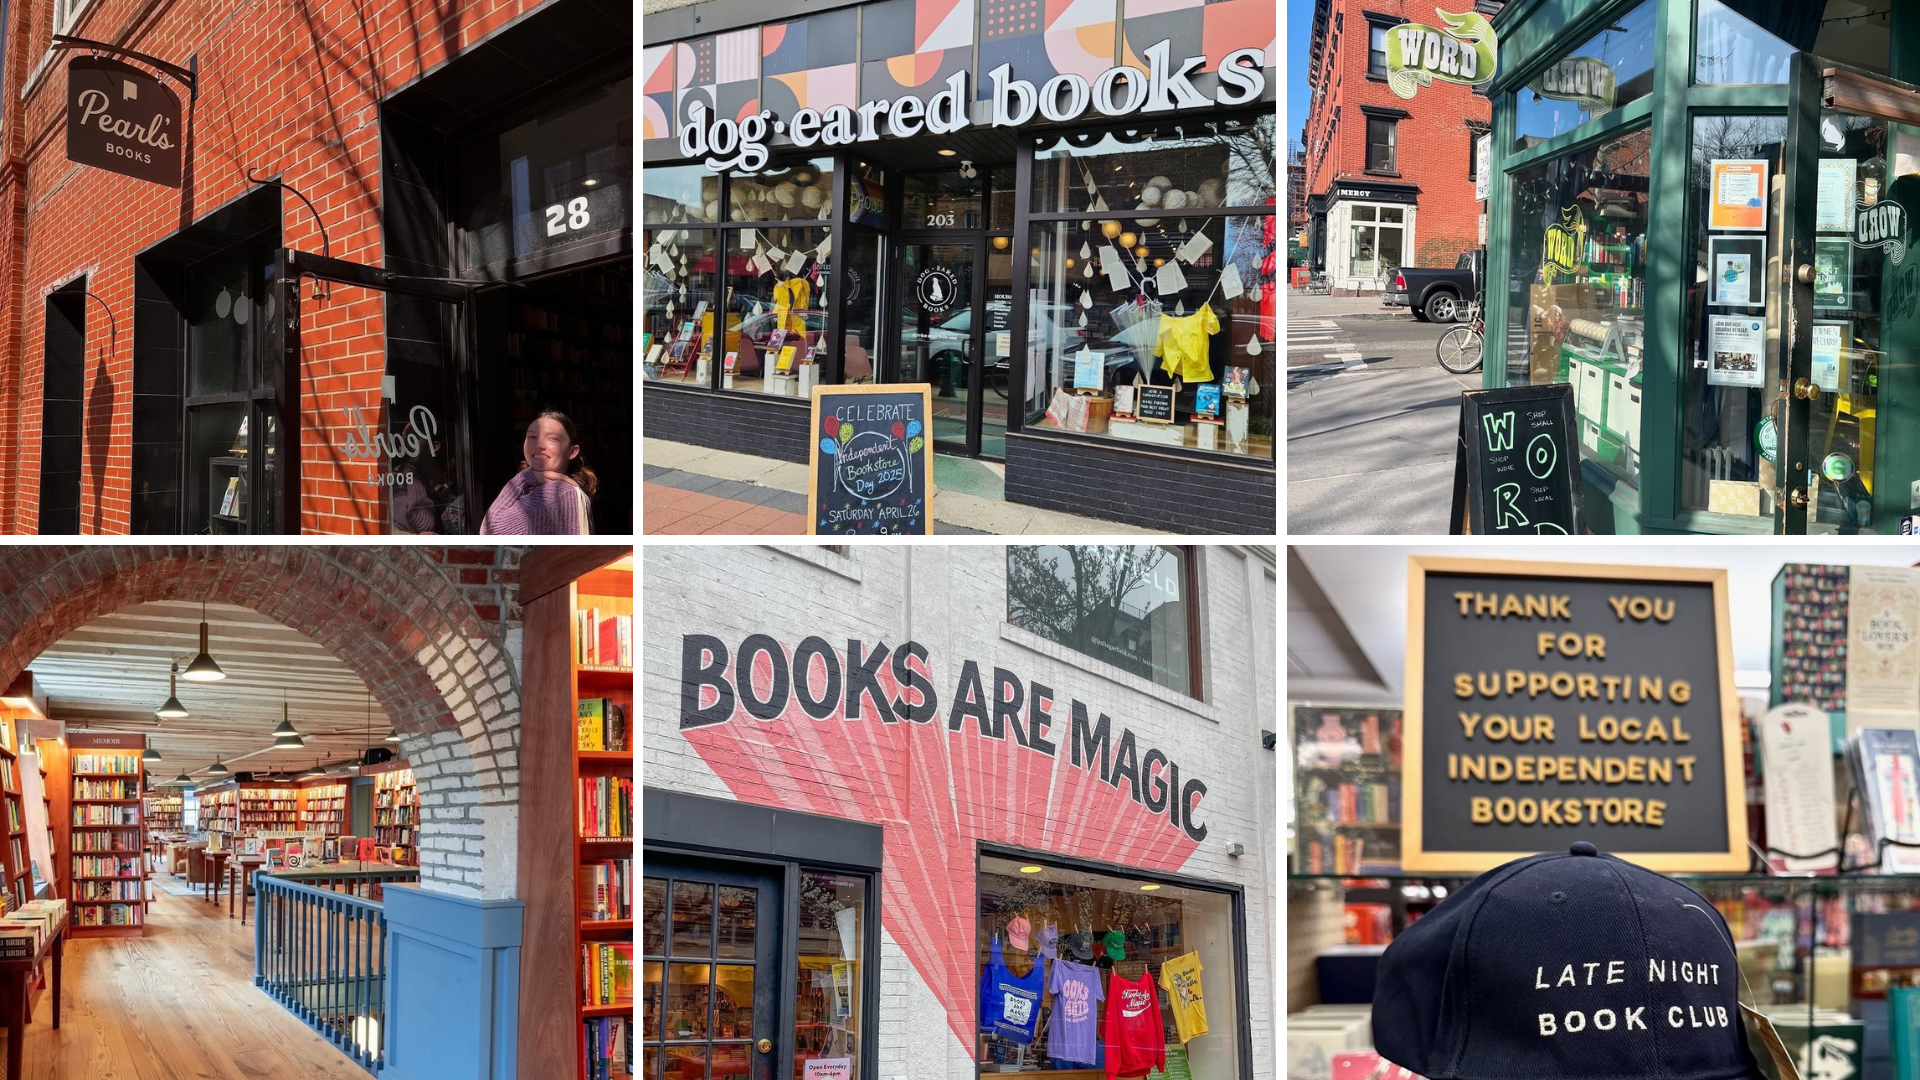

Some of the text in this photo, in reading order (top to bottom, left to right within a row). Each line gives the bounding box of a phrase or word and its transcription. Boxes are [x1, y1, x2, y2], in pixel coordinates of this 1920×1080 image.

[1398, 29, 1477, 79] WORD
[988, 38, 1266, 127] books
[78, 89, 175, 150] Pearl's
[106, 143, 152, 164] BOOKS
[1341, 189, 1370, 197] MERCY
[546, 196, 590, 237] 28
[927, 214, 955, 227] 203
[1547, 228, 1575, 268] WORD
[917, 266, 958, 285] DOG EARED
[922, 304, 950, 313] BOOKS
[836, 404, 915, 422] CELEBRATE
[1526, 410, 1546, 420] SHOP
[1531, 420, 1554, 428] SMALL
[836, 434, 898, 466] Independent
[1489, 456, 1509, 464] SHOP
[846, 456, 900, 480] Bookstore
[856, 468, 903, 494] Day 2025
[828, 504, 920, 523] SATURDAY APRIL 26
[1454, 590, 1676, 622] THANK YOU
[1536, 632, 1607, 658] FOR
[1453, 668, 1692, 704] SUPPORTING
[680, 634, 1208, 842] BOOKS ARE MAGIC
[1458, 711, 1692, 743] YOUR LOCAL
[1448, 752, 1696, 784] INDEPENDENT
[1470, 796, 1667, 826] BOOKSTORE
[1535, 958, 1719, 990] LATE NIGHT
[1010, 997, 1026, 1006] BOOKS
[1122, 988, 1142, 1000] Books
[1126, 999, 1146, 1008] Magic
[1010, 1009, 1025, 1017] MAGIC
[1538, 1005, 1729, 1036] BOOK CLUB
